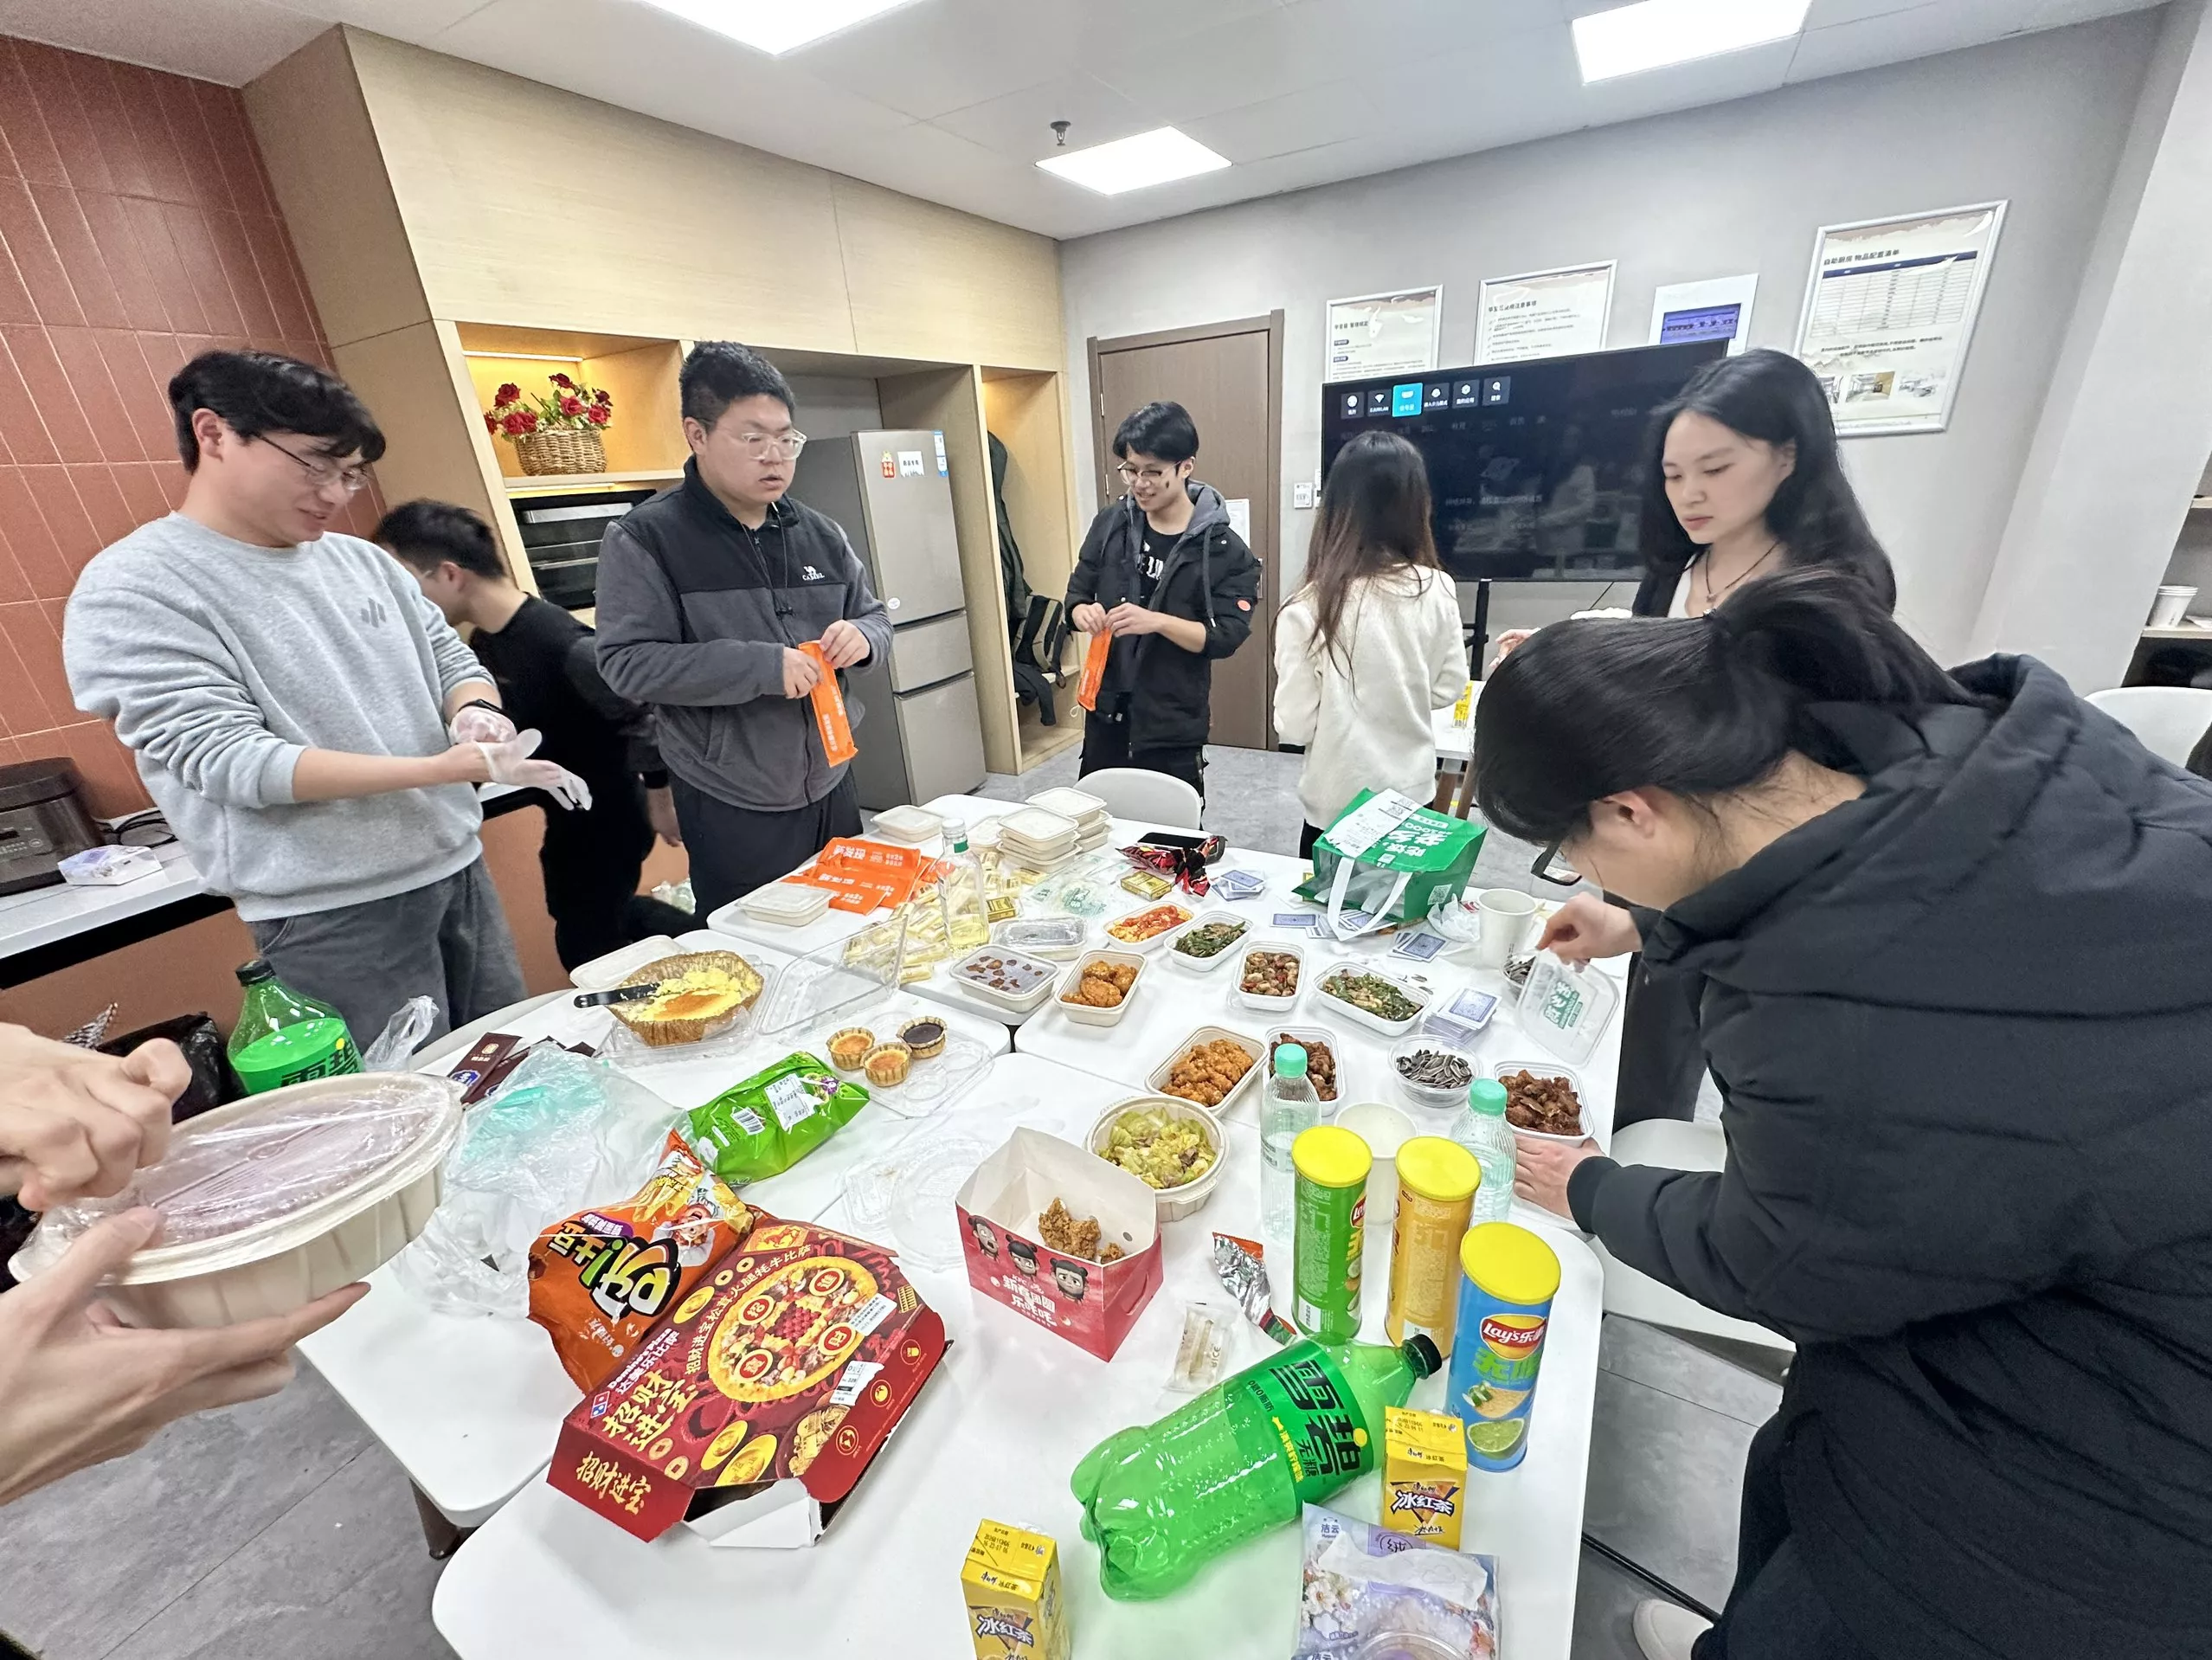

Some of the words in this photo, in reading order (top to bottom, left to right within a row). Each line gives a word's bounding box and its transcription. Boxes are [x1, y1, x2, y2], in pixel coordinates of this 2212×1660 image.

[614, 1330, 680, 1396] 达美乐比萨
[1268, 1359, 1361, 1477] 雪碧
[1294, 1438, 1320, 1477] 无糖
[576, 1450, 652, 1515] 招财进宝
[1392, 1490, 1454, 1515] 冰红茶
[1321, 1522, 1341, 1535] 洁云
[977, 1615, 1033, 1645] 冰红茶
